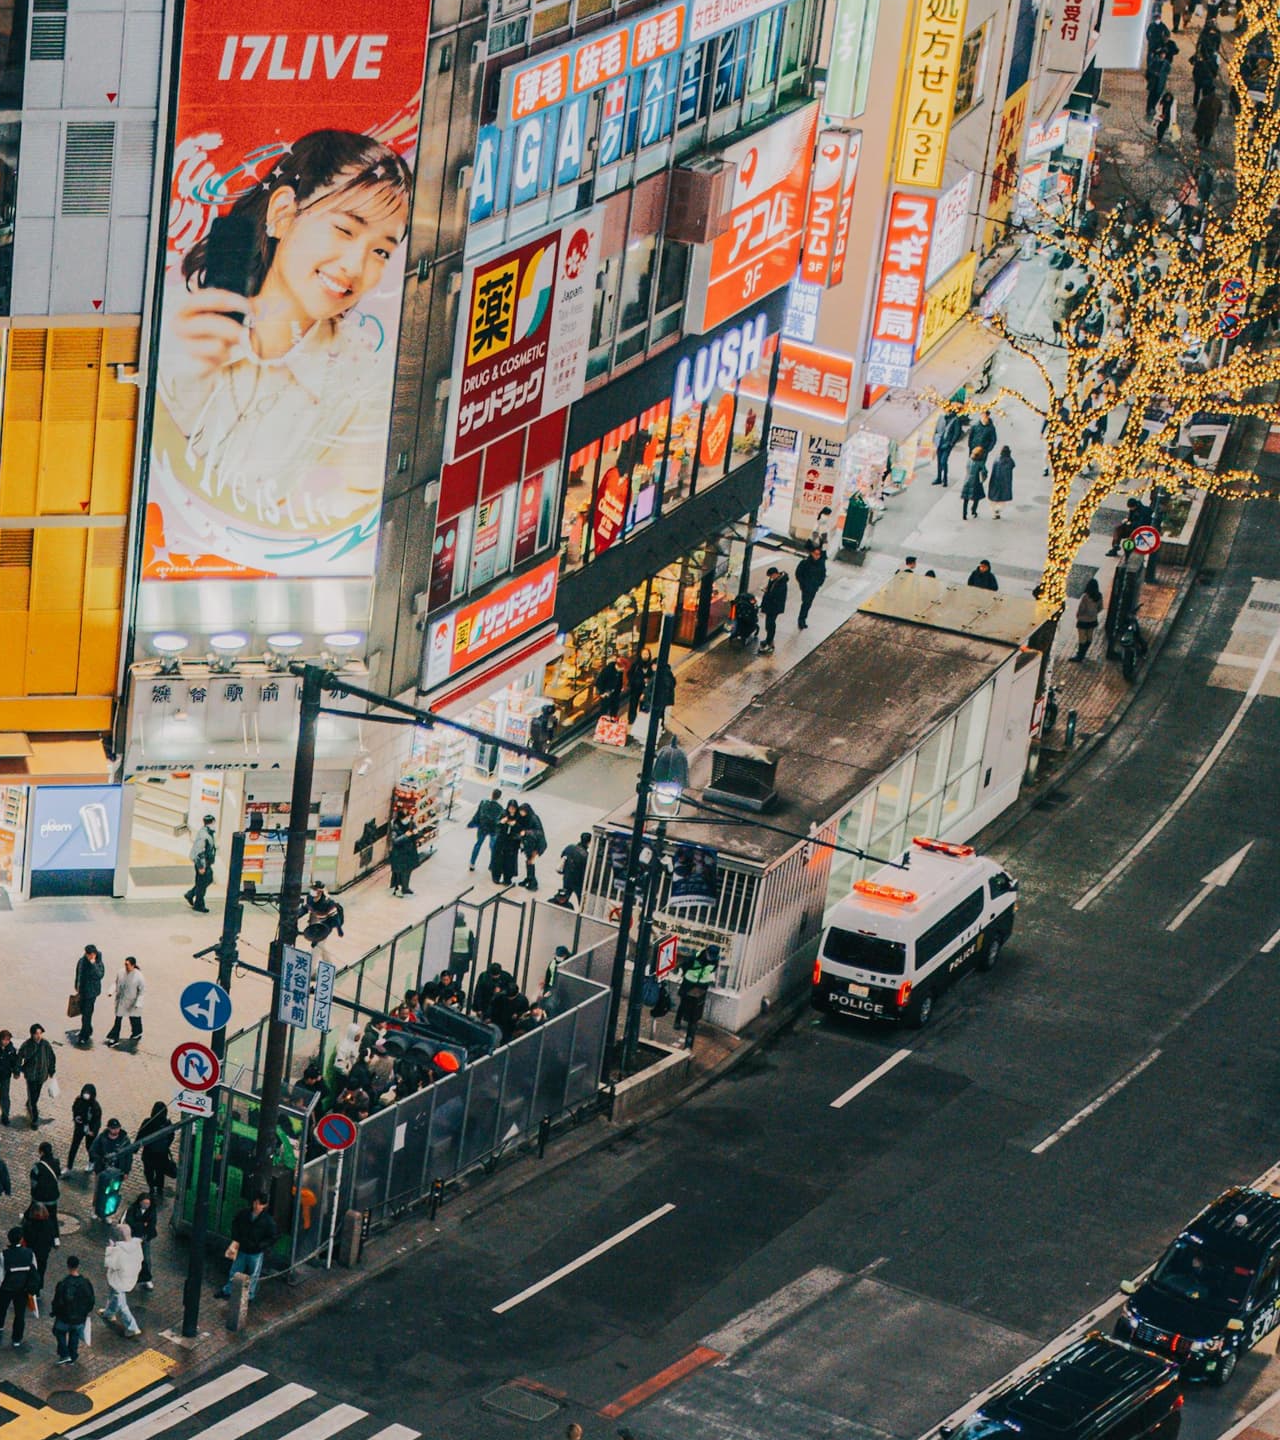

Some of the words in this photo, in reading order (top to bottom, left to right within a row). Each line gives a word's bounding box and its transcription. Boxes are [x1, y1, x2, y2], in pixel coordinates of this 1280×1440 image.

[577, 32, 624, 89] 抜毛
[637, 8, 679, 62] 発毛
[516, 58, 564, 115] 薄毛
[471, 100, 581, 209] AGA
[727, 191, 790, 265] アコム
[807, 196, 833, 257] アコム
[741, 263, 763, 299] 3F
[807, 260, 823, 273] 3F
[876, 200, 929, 341] スギ薬局
[472, 271, 514, 356] 薬
[463, 369, 490, 396] DRUG
[490, 364, 500, 383] &
[499, 341, 546, 378] COSMETIC
[671, 312, 769, 420] LUSH
[39, 819, 73, 839] ploom
[948, 943, 977, 973] POLICE
[291, 954, 309, 1023] 渋谷駅前
[828, 992, 884, 1014] POLICE
